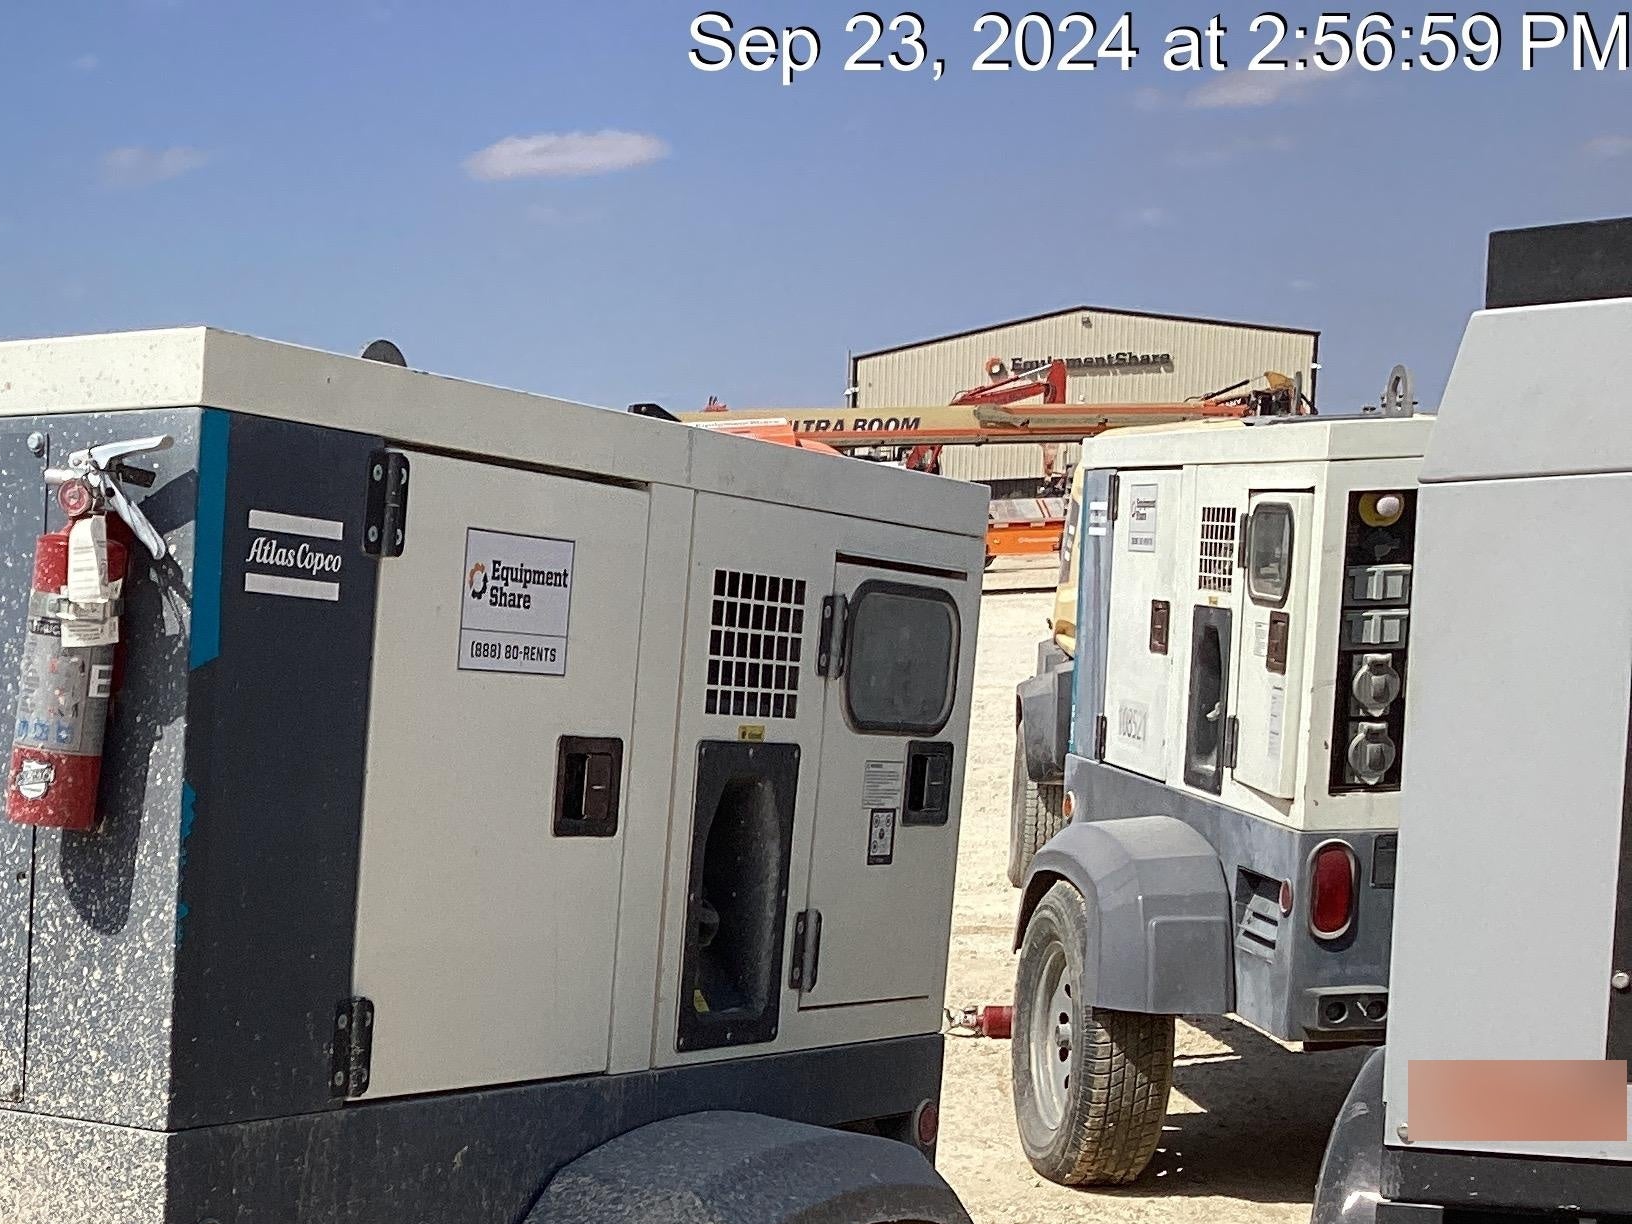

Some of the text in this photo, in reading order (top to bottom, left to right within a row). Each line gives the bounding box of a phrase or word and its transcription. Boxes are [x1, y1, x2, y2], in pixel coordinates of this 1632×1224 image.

[245, 537, 342, 575] Atlas Copco
[491, 560, 569, 588] Equipment
[489, 585, 531, 610] Share
[470, 640, 557, 662] (888) 80-RENTS
